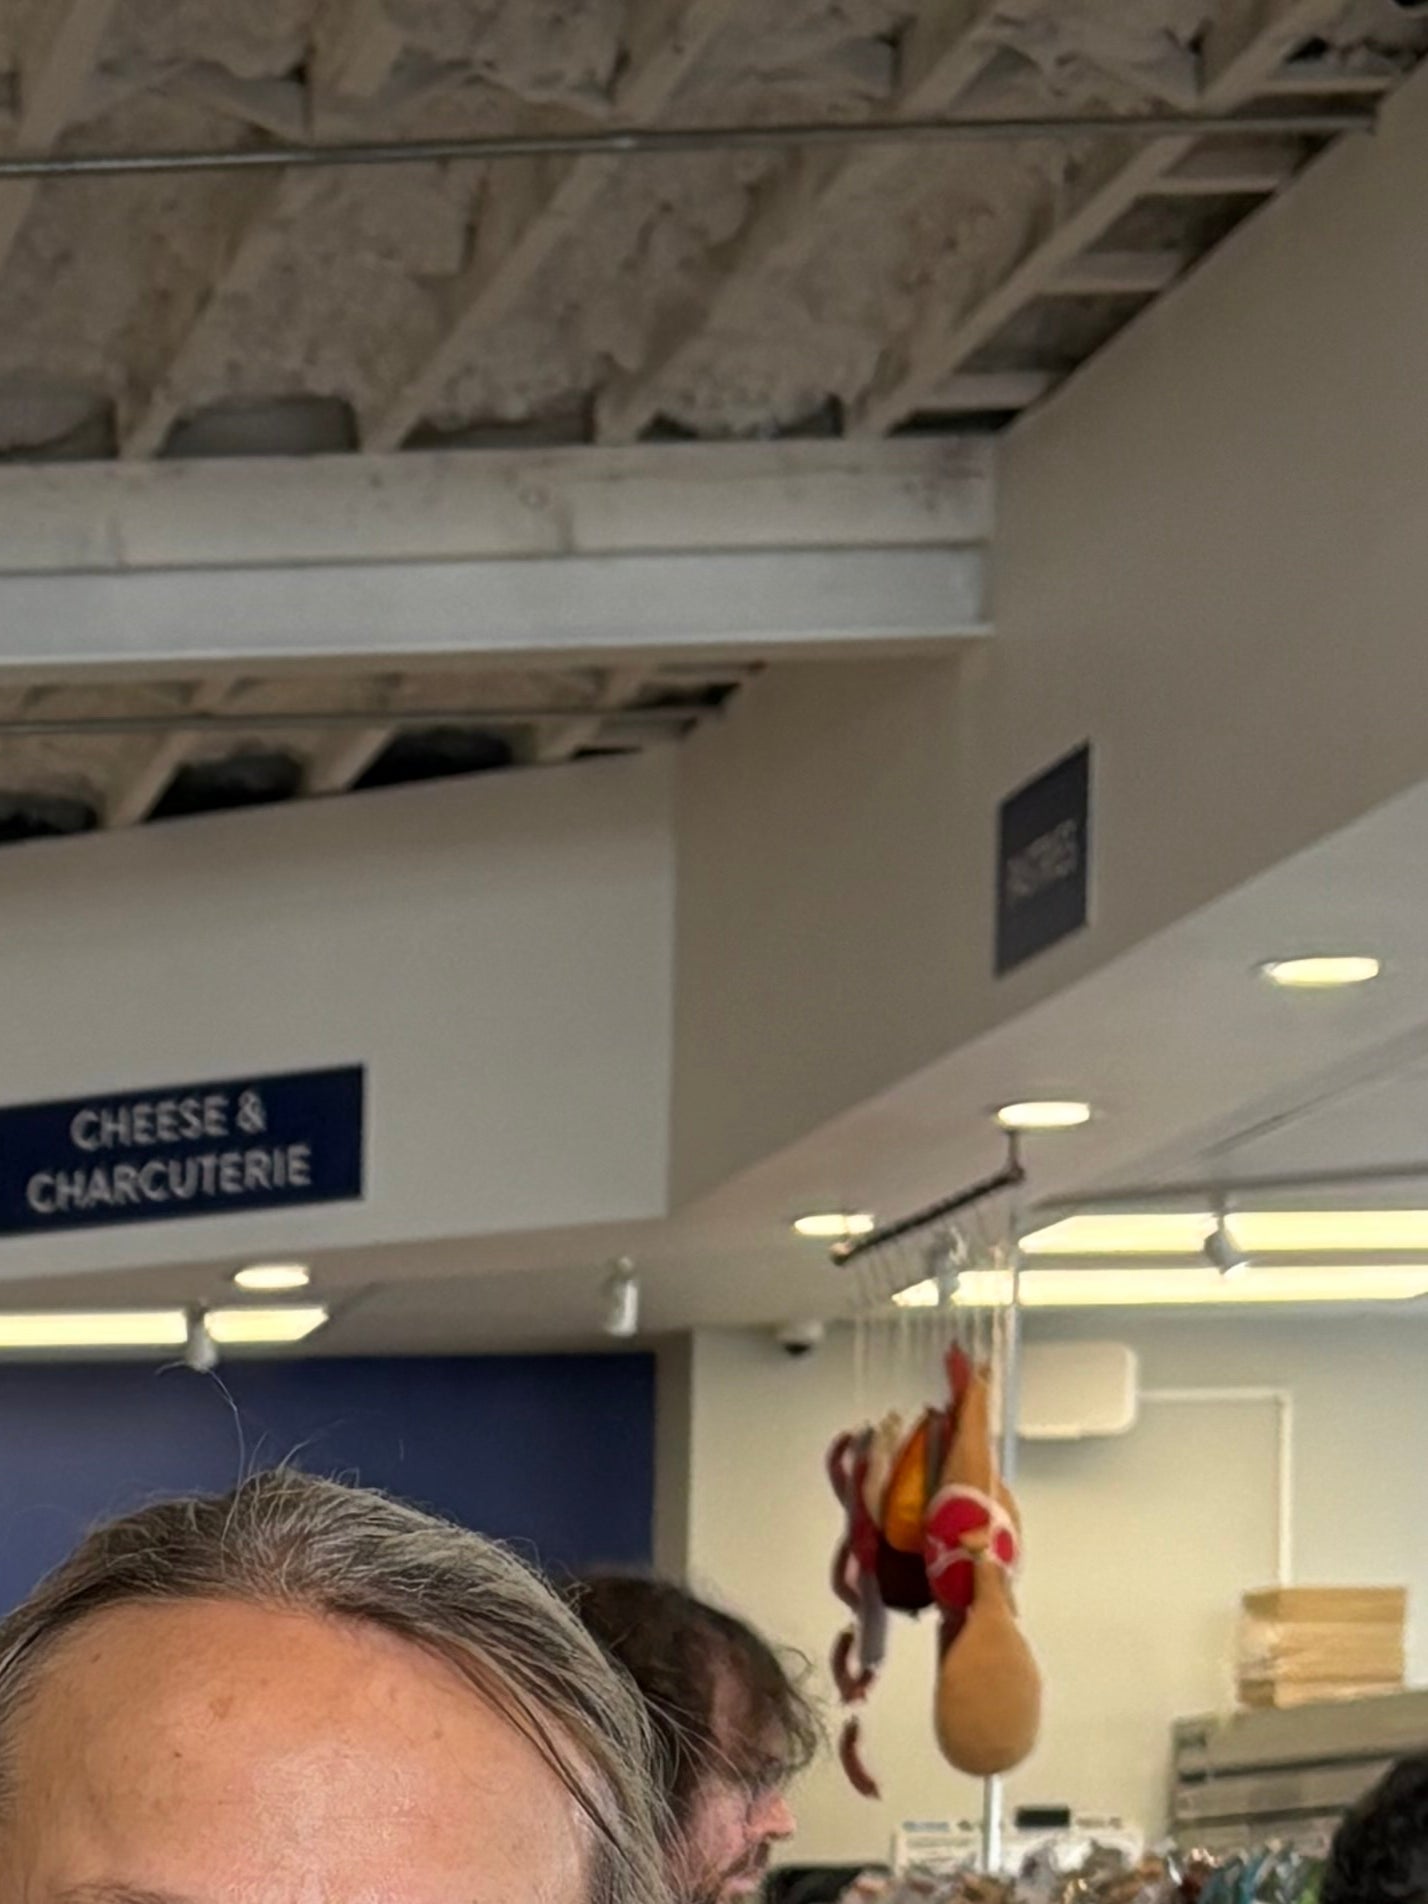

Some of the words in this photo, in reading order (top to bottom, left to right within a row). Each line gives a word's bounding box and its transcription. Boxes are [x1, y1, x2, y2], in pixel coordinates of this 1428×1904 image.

[69, 1094, 229, 1152] CHEESE
[236, 1089, 267, 1135] &
[25, 1143, 313, 1214] CHARCUTERIE
